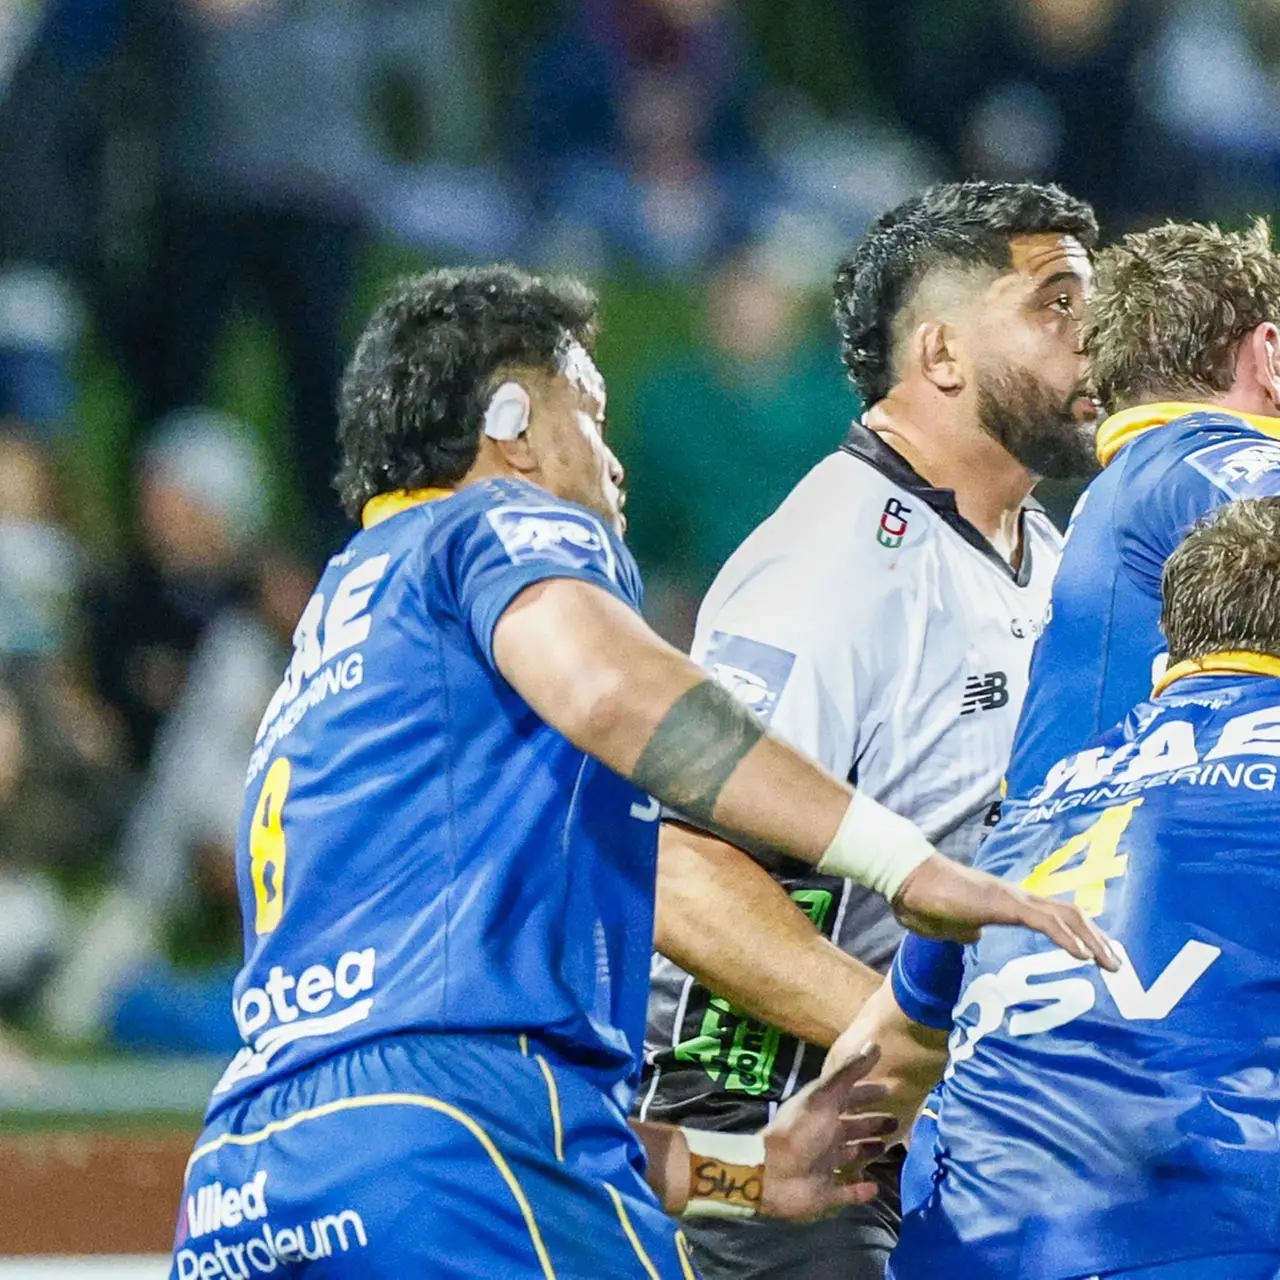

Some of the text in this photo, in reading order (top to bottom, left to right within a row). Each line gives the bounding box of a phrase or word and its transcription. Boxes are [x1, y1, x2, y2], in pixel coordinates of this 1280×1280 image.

[876, 497, 912, 549] ECR
[249, 756, 292, 936] 8
[1021, 796, 1146, 919] 4
[232, 946, 376, 1042] otea
